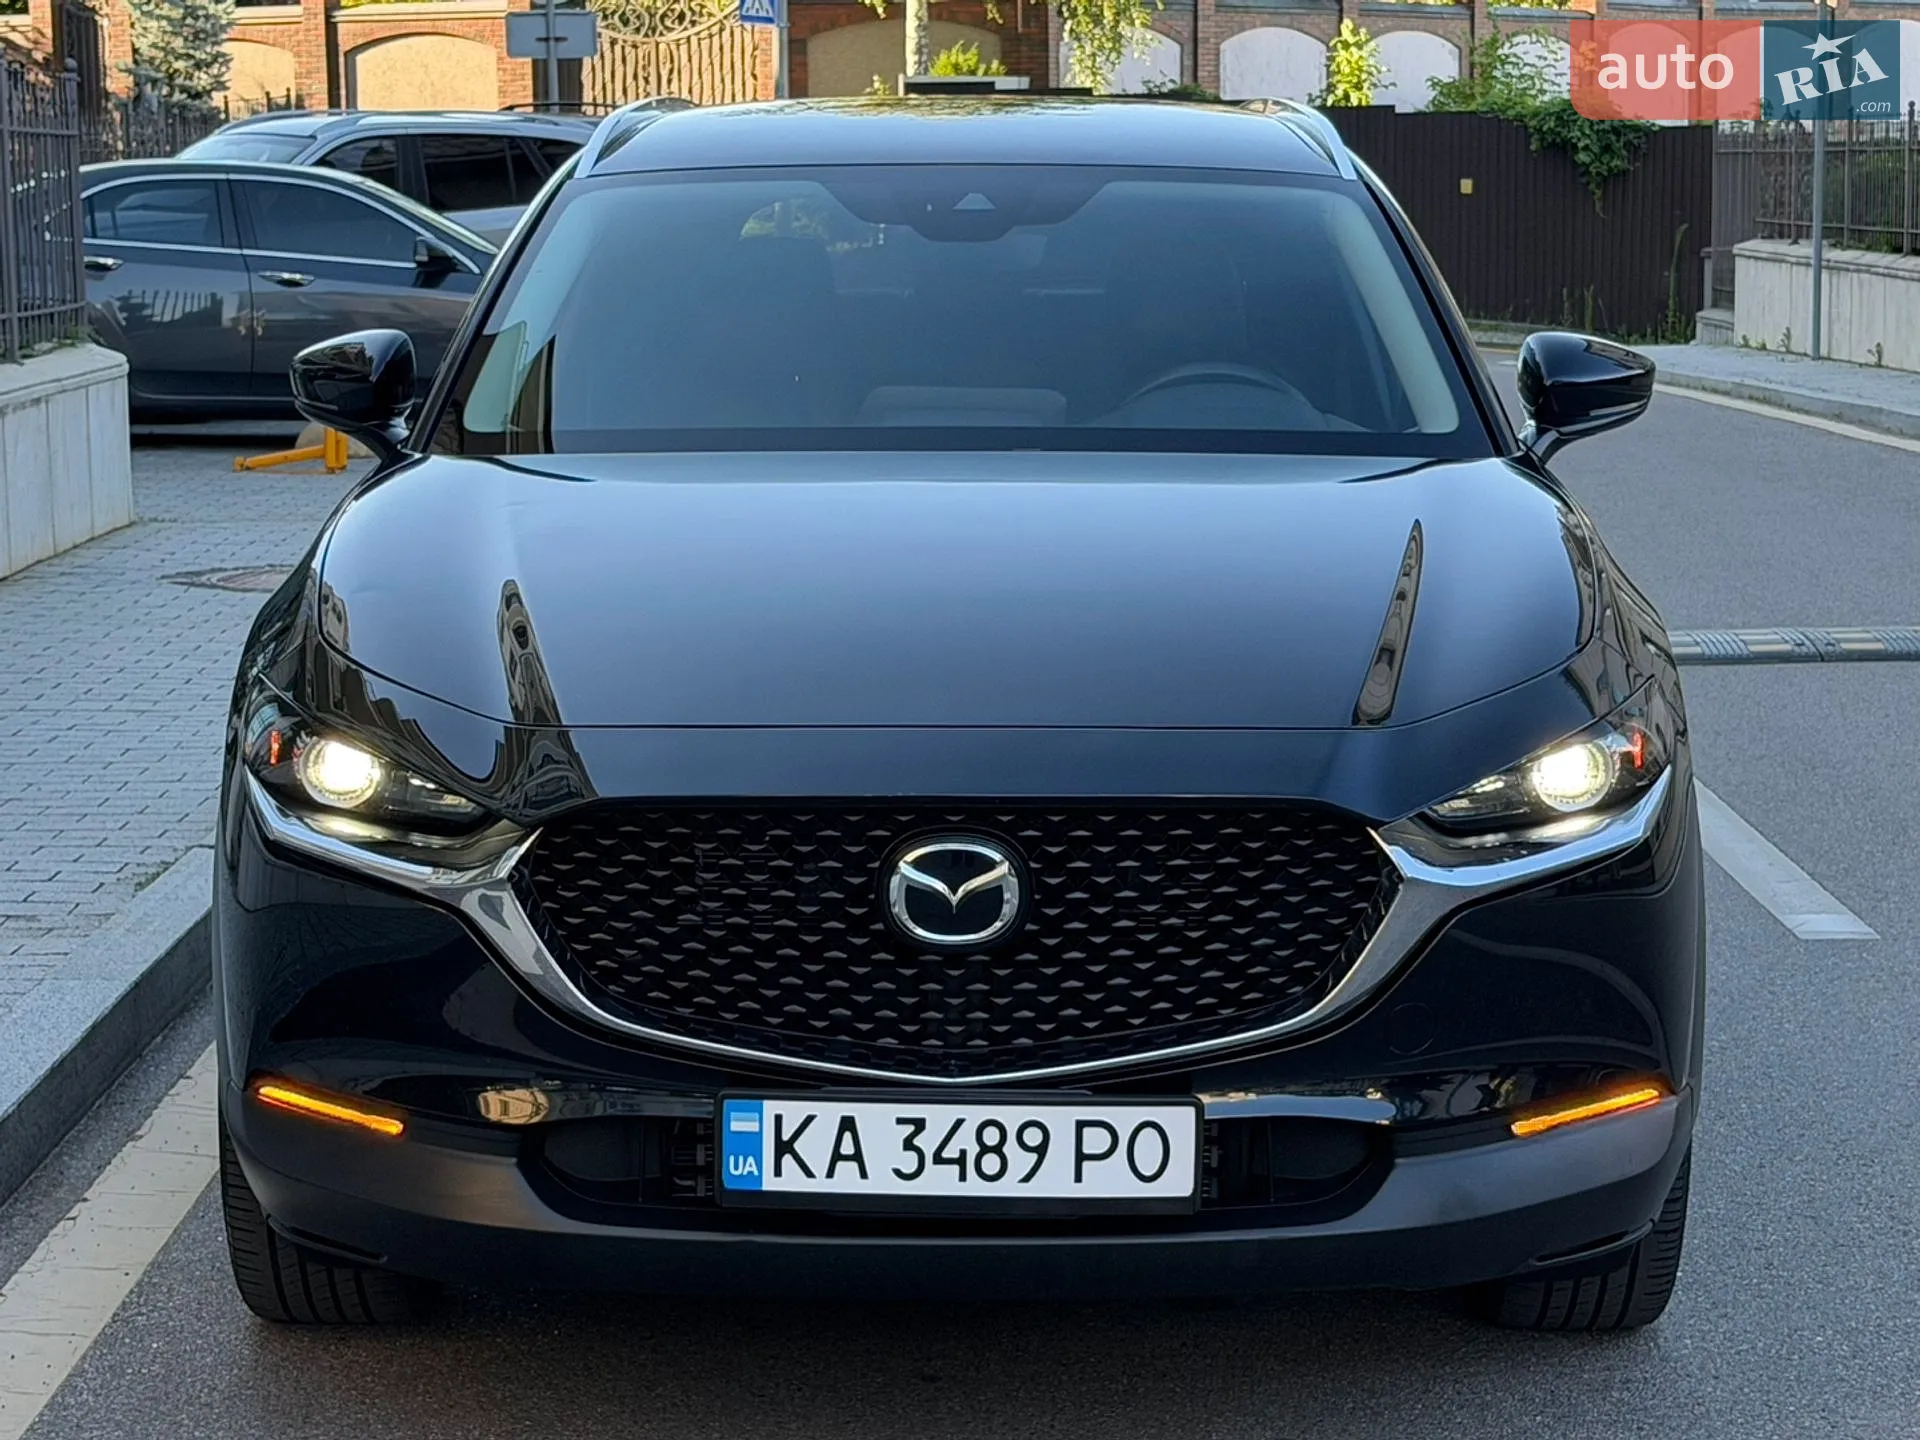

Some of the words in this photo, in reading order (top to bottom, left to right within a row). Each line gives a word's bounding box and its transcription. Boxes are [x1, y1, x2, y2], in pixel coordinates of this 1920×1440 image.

[728, 1155, 759, 1177] UA
[773, 1113, 869, 1180] KA
[891, 1116, 1051, 1183] 3489
[1074, 1119, 1171, 1184] PO
